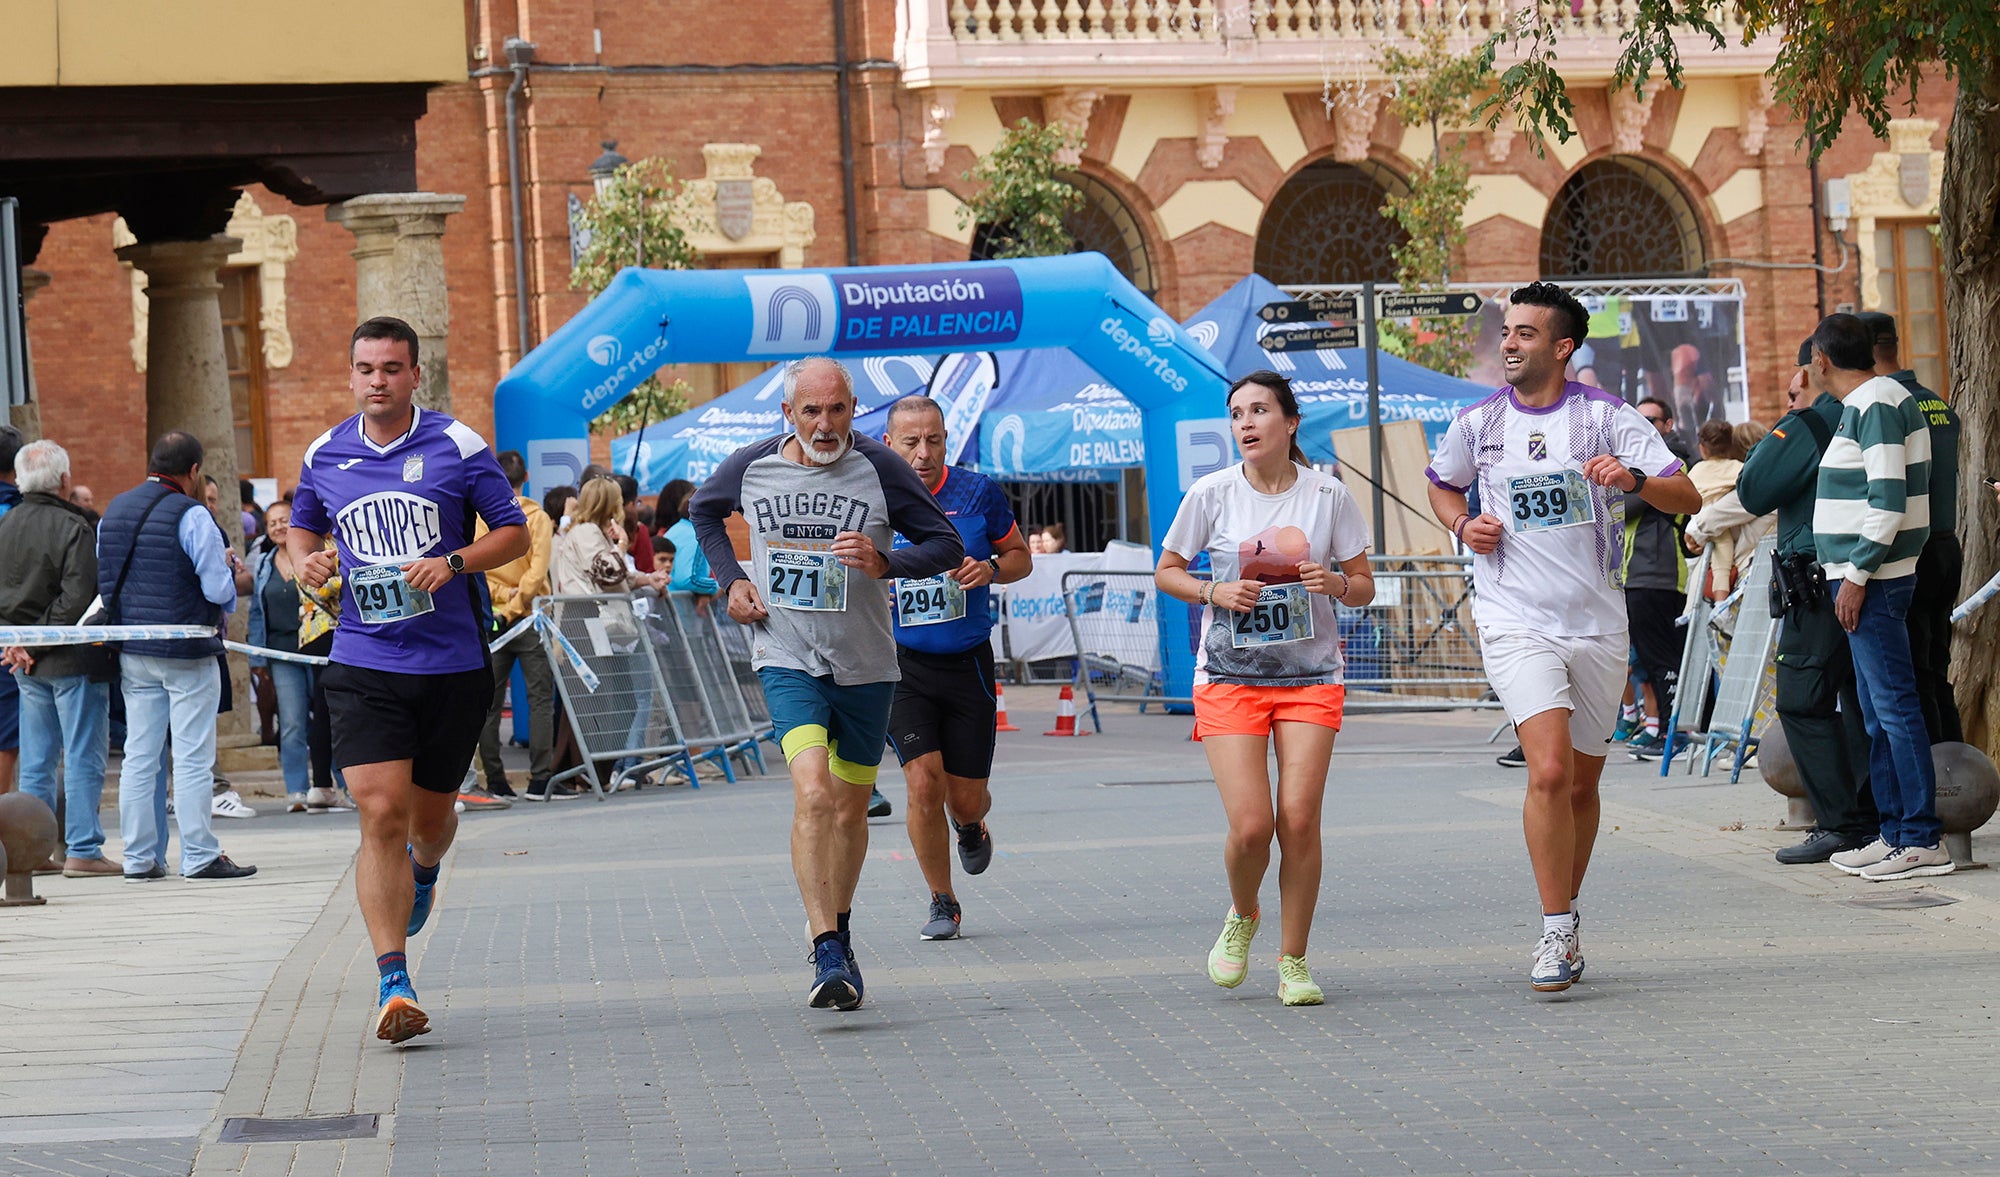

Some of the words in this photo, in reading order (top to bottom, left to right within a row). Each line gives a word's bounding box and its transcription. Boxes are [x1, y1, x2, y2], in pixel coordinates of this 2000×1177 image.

[843, 279, 985, 310] Diputación
[1308, 300, 1326, 310] San
[1327, 299, 1353, 309] Pedro
[1385, 296, 1415, 307] Iglesia
[1416, 296, 1447, 304] museo
[845, 316, 883, 340] DE
[889, 309, 1017, 338] PALENCIA
[1385, 308, 1411, 317] Santa
[1286, 331, 1311, 341] Canal
[1323, 328, 1355, 338] Castilla
[1100, 317, 1188, 392] deportes
[581, 336, 669, 410] deportes
[1930, 413, 1950, 426] CIVIL
[1070, 443, 1092, 467] DE
[752, 493, 870, 533] RUGGED
[1513, 488, 1568, 521] 339
[339, 497, 438, 557] TECNIPEC
[786, 527, 795, 535] 19
[797, 526, 823, 538] NYC
[824, 528, 834, 536] 78
[355, 580, 403, 611] 291
[771, 566, 819, 598] 271
[901, 587, 947, 615] 294
[1234, 602, 1290, 635] 250
